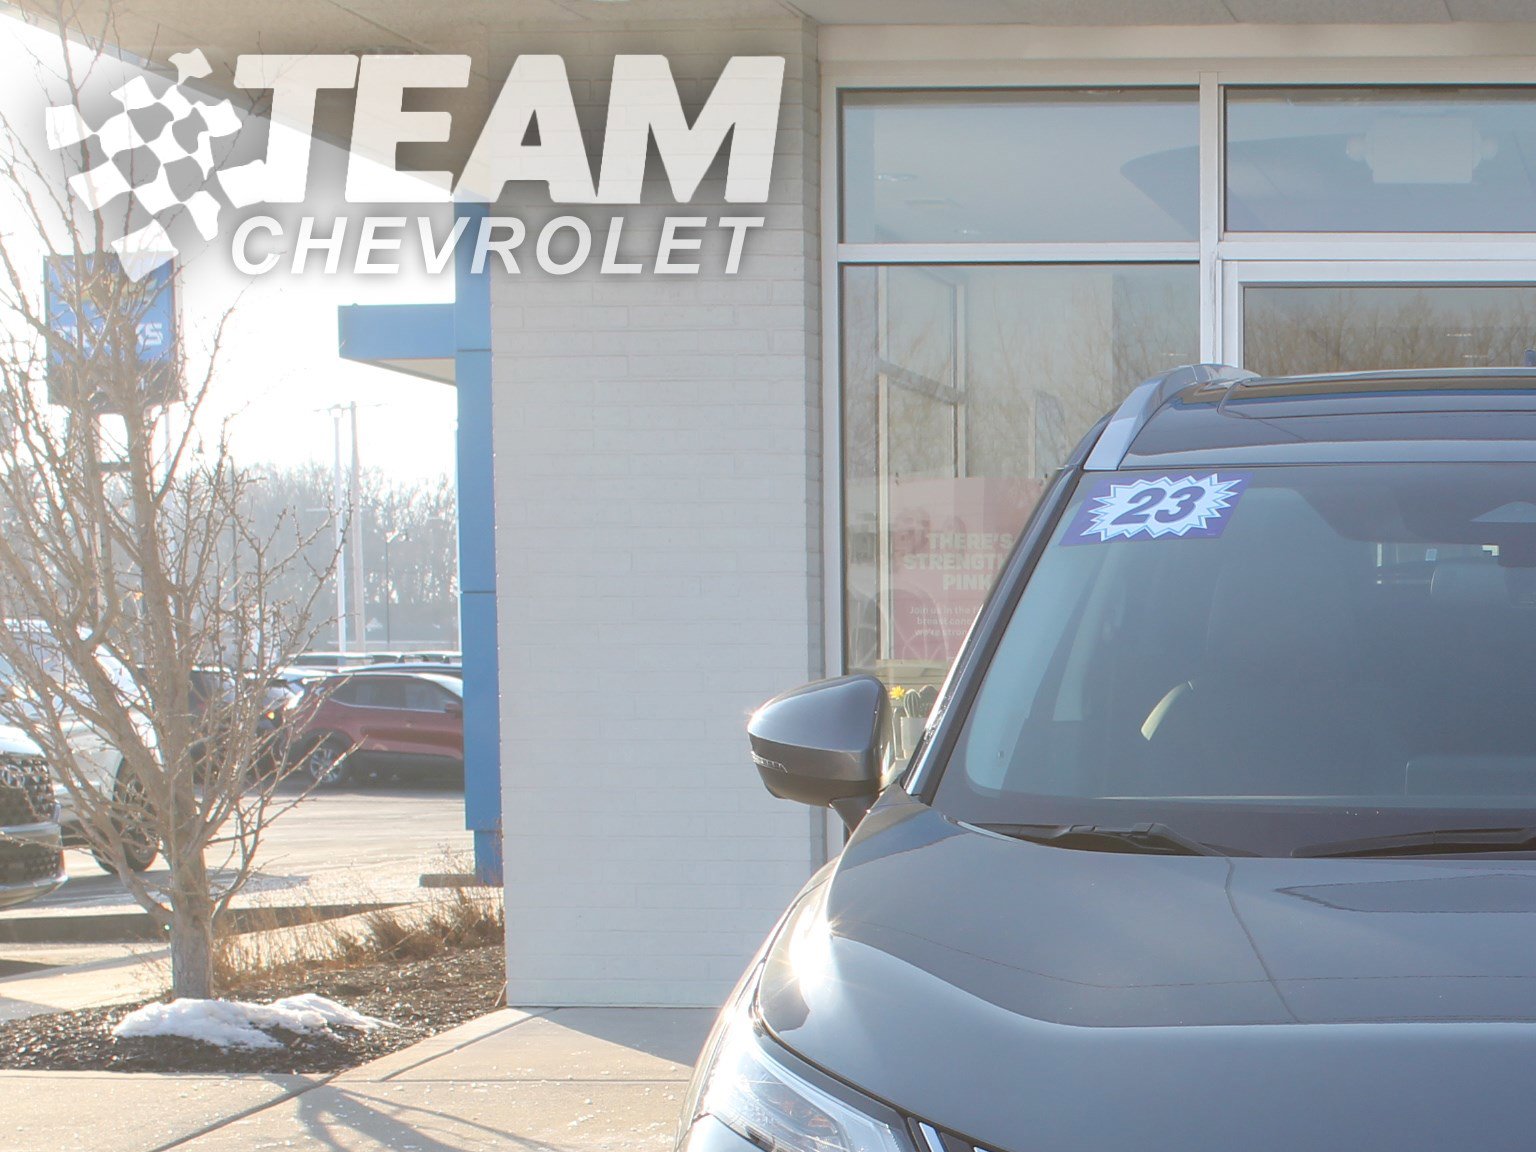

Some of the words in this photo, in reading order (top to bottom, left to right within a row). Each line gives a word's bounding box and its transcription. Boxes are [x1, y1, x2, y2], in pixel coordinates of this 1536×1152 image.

[1110, 486, 1206, 526] 23
[928, 533, 1015, 549] THERE'S
[943, 574, 994, 590] PINK
